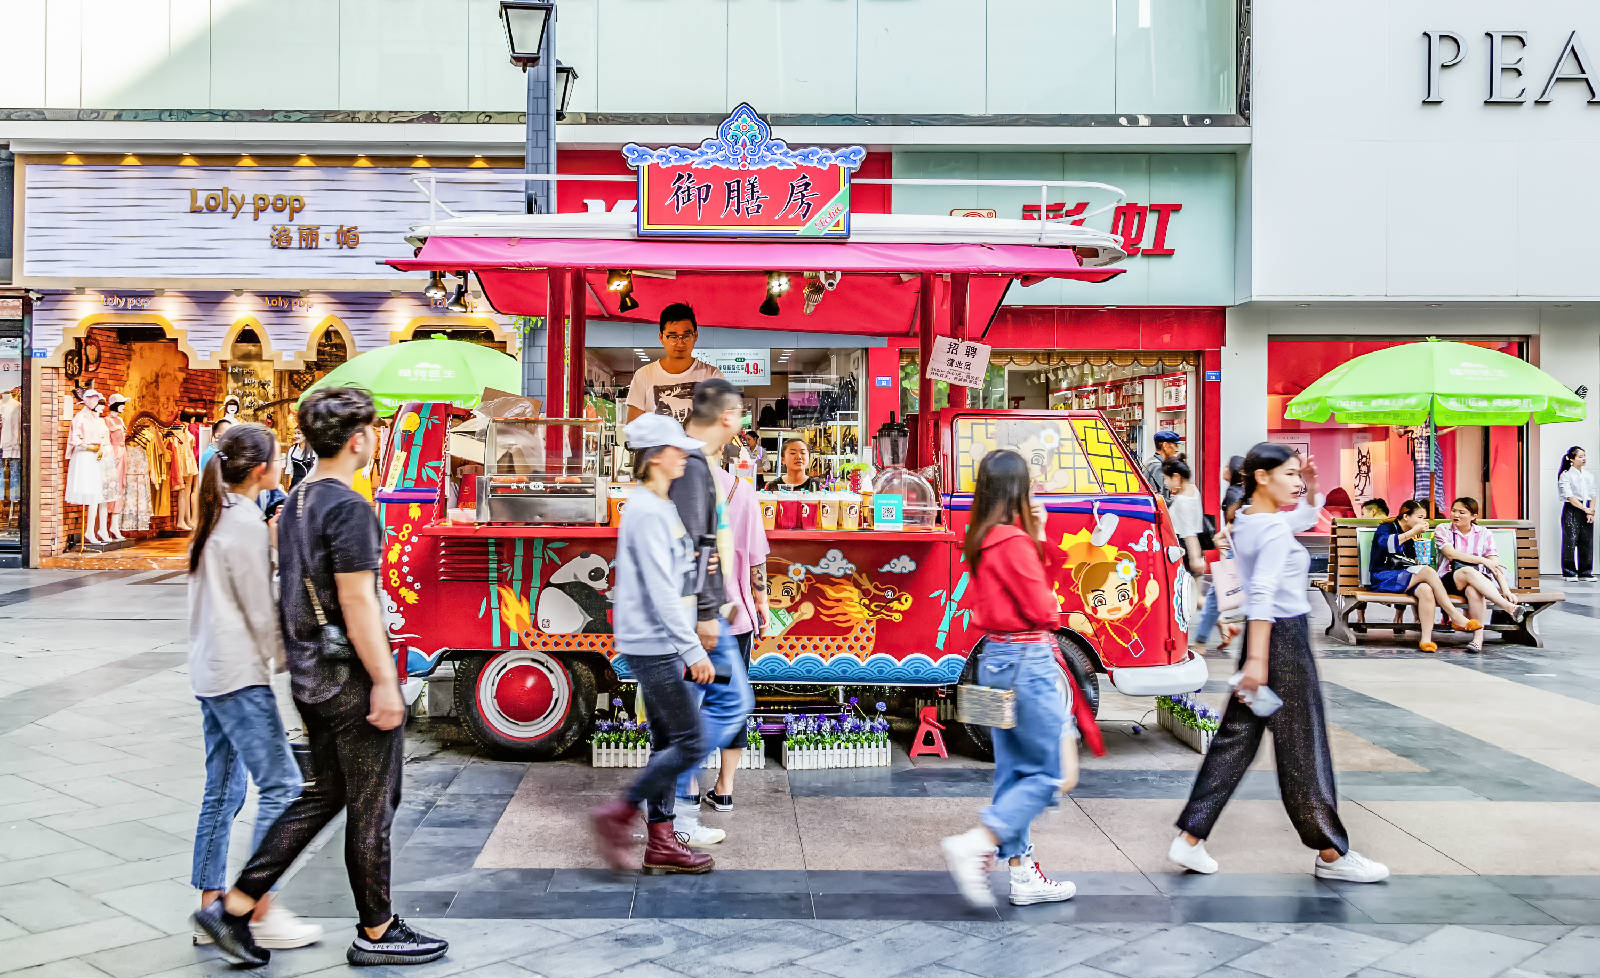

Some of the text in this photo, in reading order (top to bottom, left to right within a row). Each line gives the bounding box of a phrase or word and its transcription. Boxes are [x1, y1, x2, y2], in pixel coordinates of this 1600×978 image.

[1422, 30, 1600, 105] PEA
[189, 186, 306, 221] Loly pop
[665, 172, 820, 220] 御膳房
[264, 295, 289, 309] Loly
